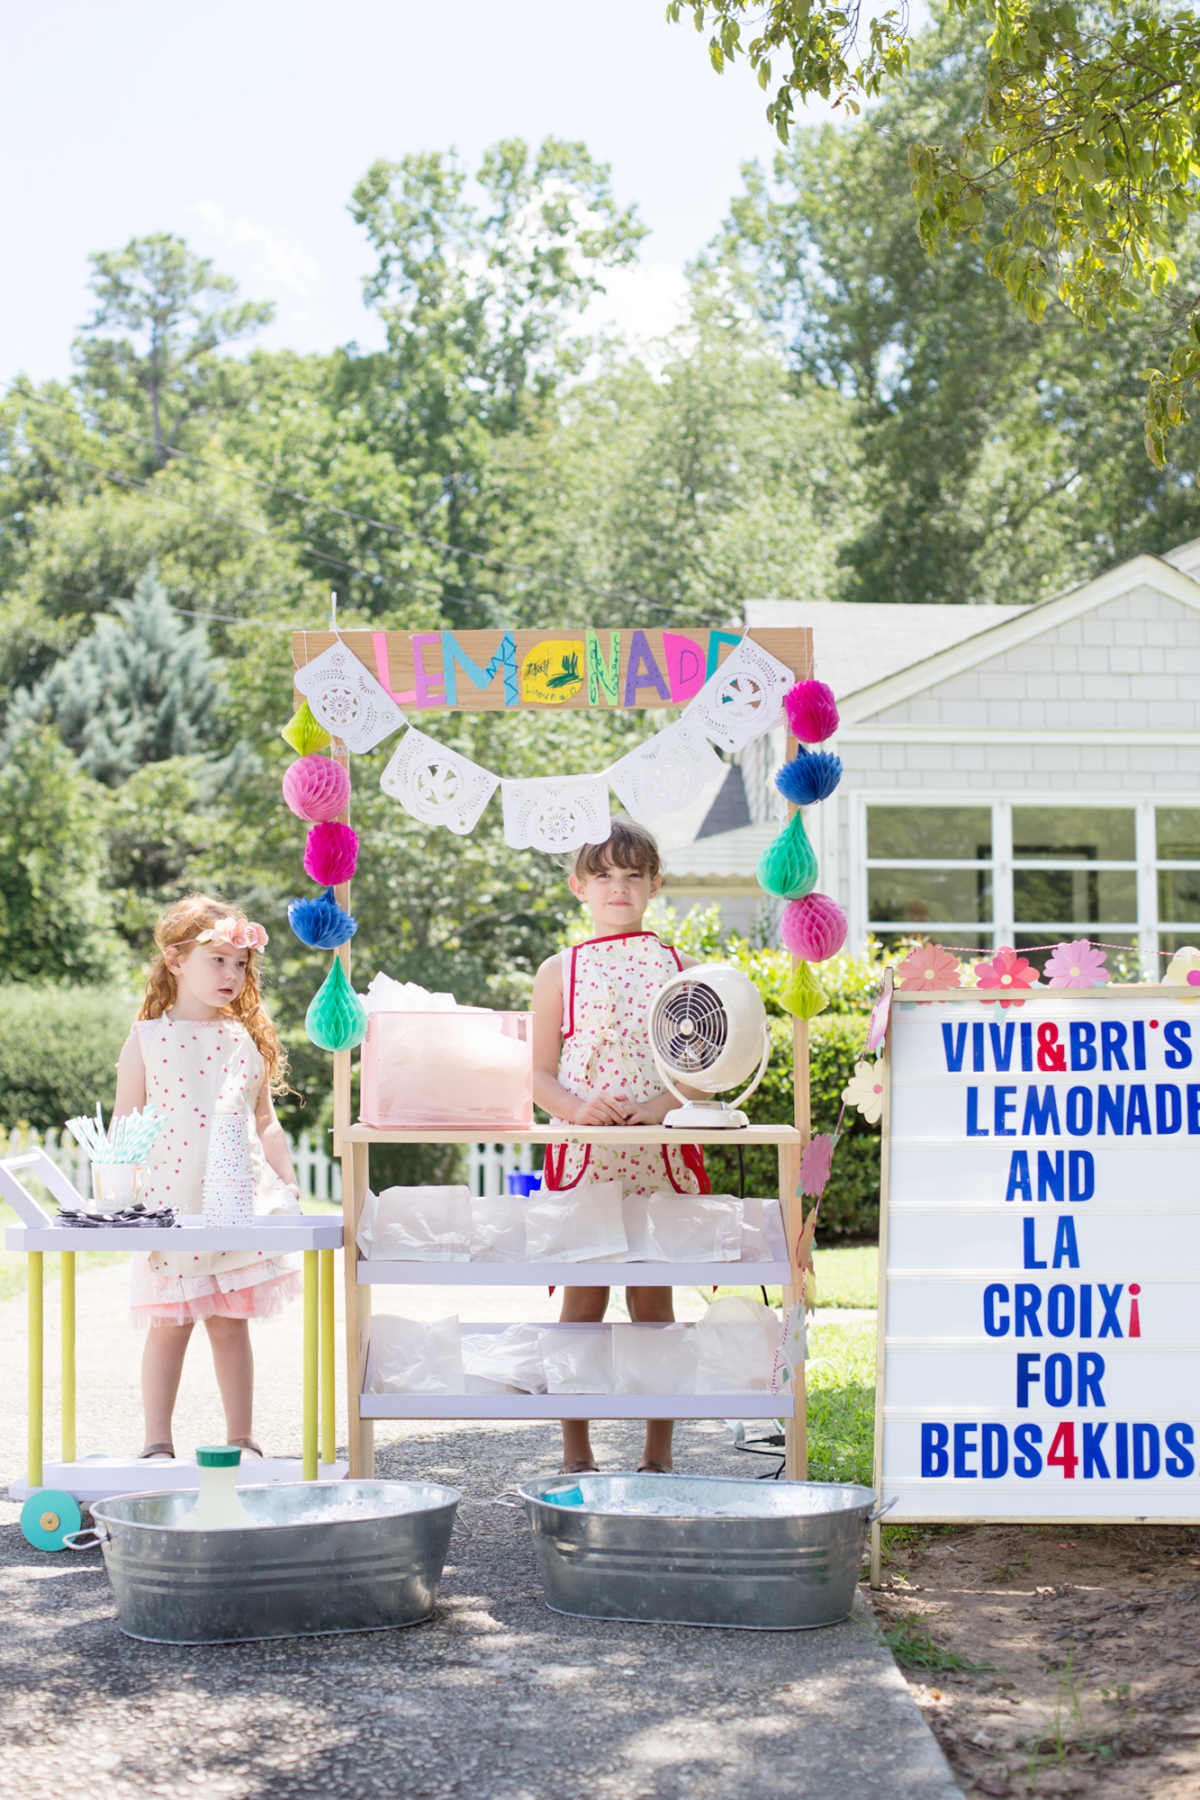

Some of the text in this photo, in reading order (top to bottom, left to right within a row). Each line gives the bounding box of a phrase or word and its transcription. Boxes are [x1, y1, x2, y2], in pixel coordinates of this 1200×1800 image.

[966, 1083, 1200, 1137] LEMONADE
[1006, 1150, 1095, 1202] AND
[1023, 1216, 1081, 1269] LA
[1016, 1352, 1106, 1408] FOR
[920, 1421, 1195, 1480] BEDS4KIDS
